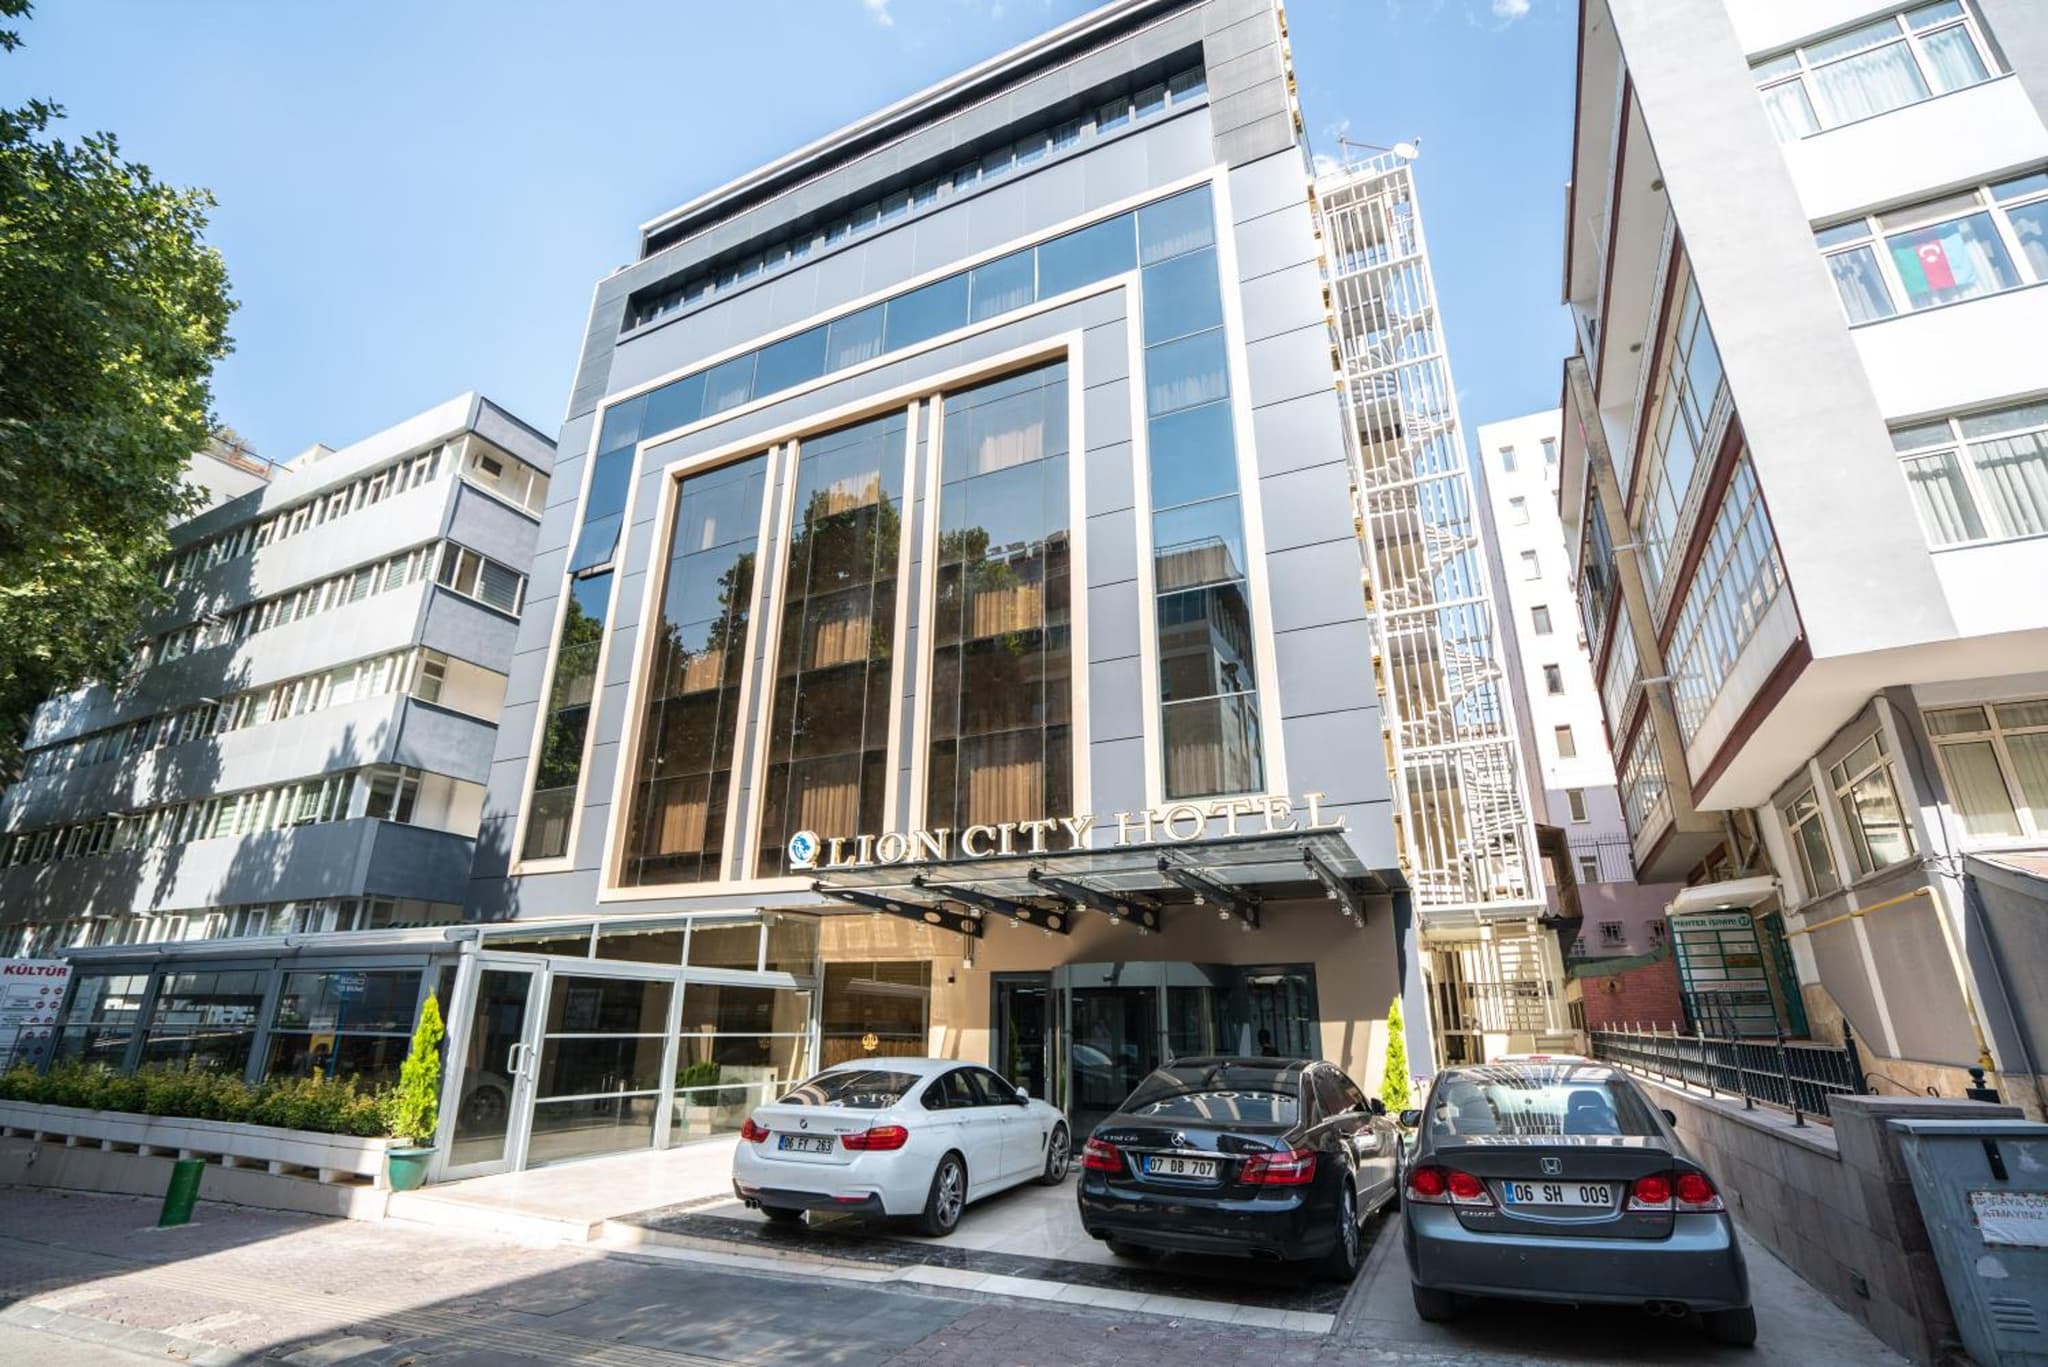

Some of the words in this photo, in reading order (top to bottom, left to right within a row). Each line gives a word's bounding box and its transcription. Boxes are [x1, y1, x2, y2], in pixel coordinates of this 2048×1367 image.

[826, 827, 950, 867] LION
[961, 815, 1097, 858] CITY
[1112, 791, 1346, 847] HOTEL
[4, 963, 68, 977] KÜLTÜR
[784, 1136, 794, 1149] 06
[798, 1137, 809, 1150] FY
[1150, 1158, 1163, 1171] 07
[1170, 1160, 1184, 1174] DB
[1191, 1161, 1214, 1176] 707
[1515, 1184, 1534, 1201] 06
[1544, 1185, 1564, 1202] SH
[1579, 1186, 1609, 1204] 009
